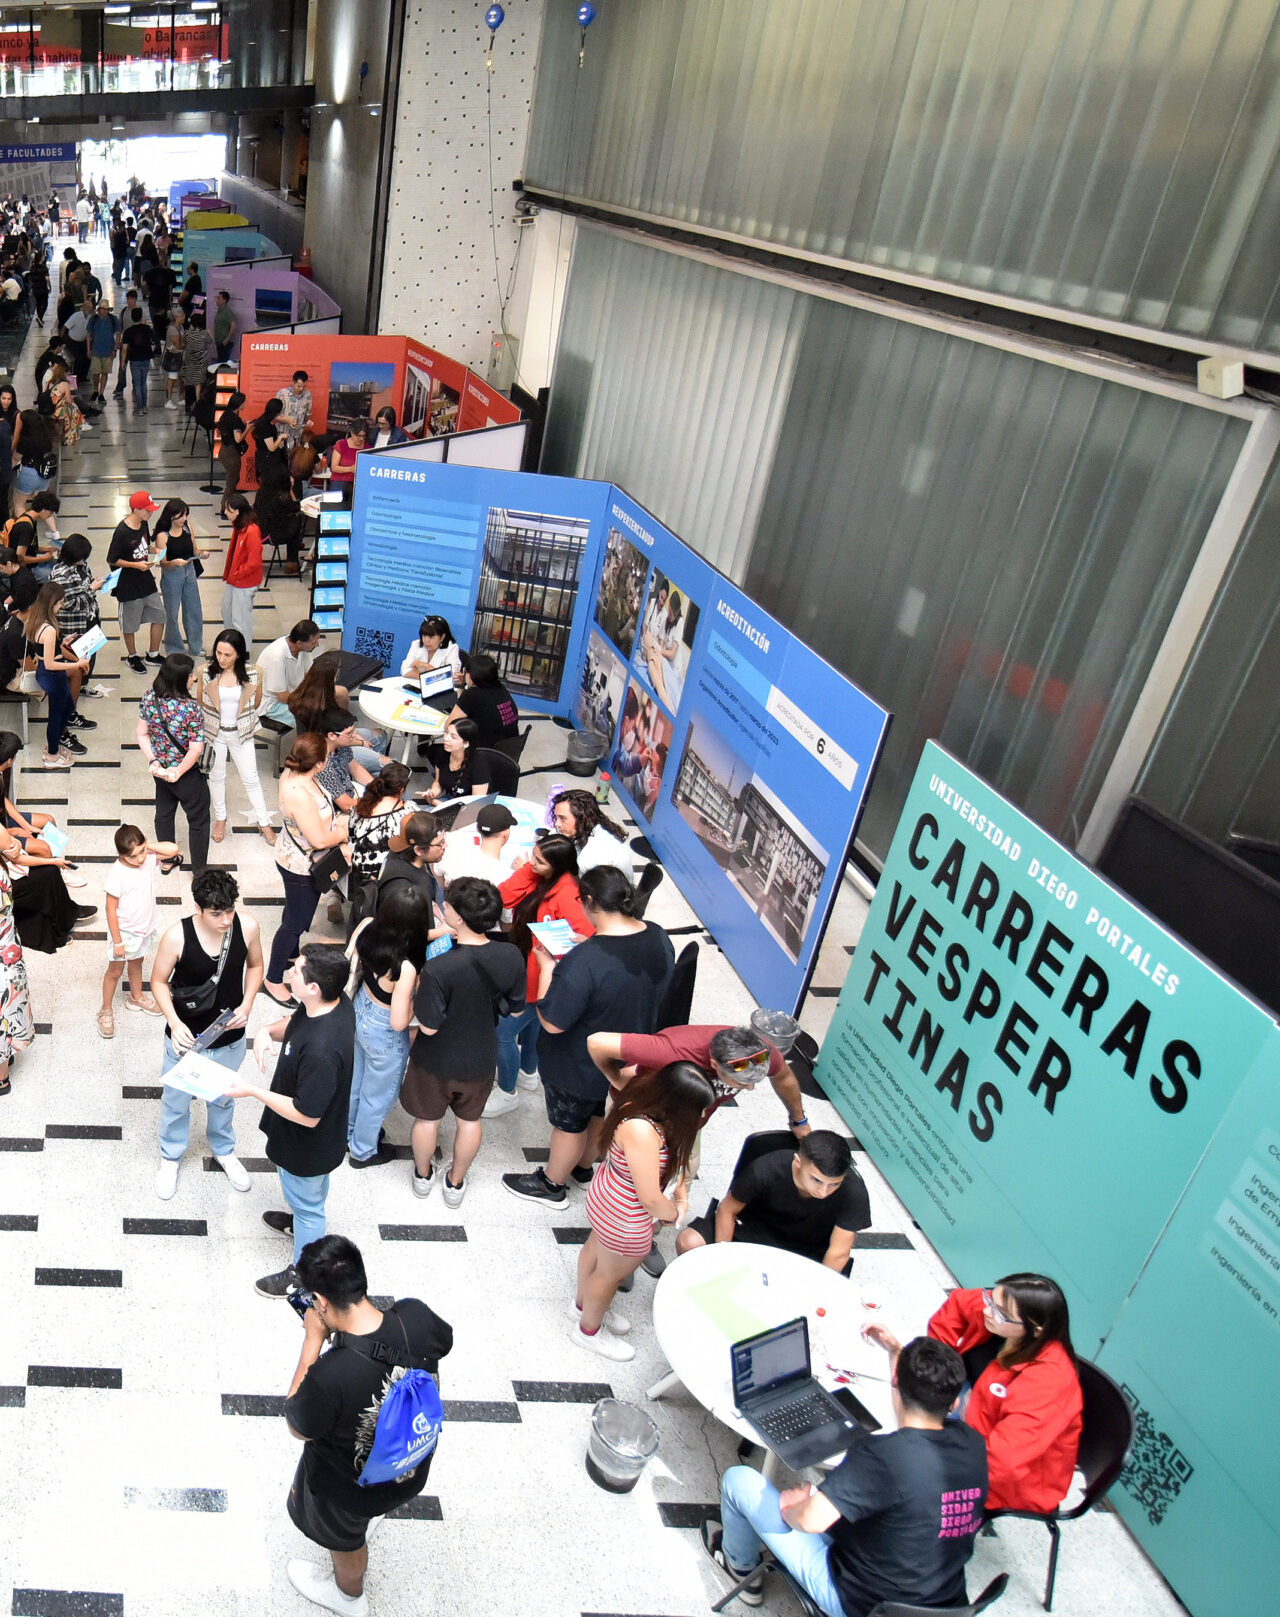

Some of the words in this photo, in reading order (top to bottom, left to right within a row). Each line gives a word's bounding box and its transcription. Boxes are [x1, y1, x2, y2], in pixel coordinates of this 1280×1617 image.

[7, 147, 64, 158] FACULTADES
[250, 342, 289, 351] CARRERAS
[369, 466, 426, 483] CARRERAS
[716, 599, 771, 654] ACREDITACIÓN
[816, 737, 826, 755] 6
[929, 774, 1022, 863] UNIVERSIDAD
[1028, 857, 1079, 911] DIEGO
[1085, 906, 1182, 996] PORTALES
[908, 812, 1202, 1115] CARRERAS
[882, 880, 1072, 1116] VESPER
[863, 949, 1004, 1143] TINAS
[852, 1028, 886, 1074] Universidad
[886, 1071, 904, 1097] Diego
[904, 1093, 931, 1131] Portales
[1244, 1187, 1260, 1204] de
[1228, 1216, 1280, 1271] Ingeniería
[1210, 1246, 1262, 1302] Ingeniería
[1263, 1300, 1278, 1319] en
[941, 1487, 982, 1503] UNIVER
